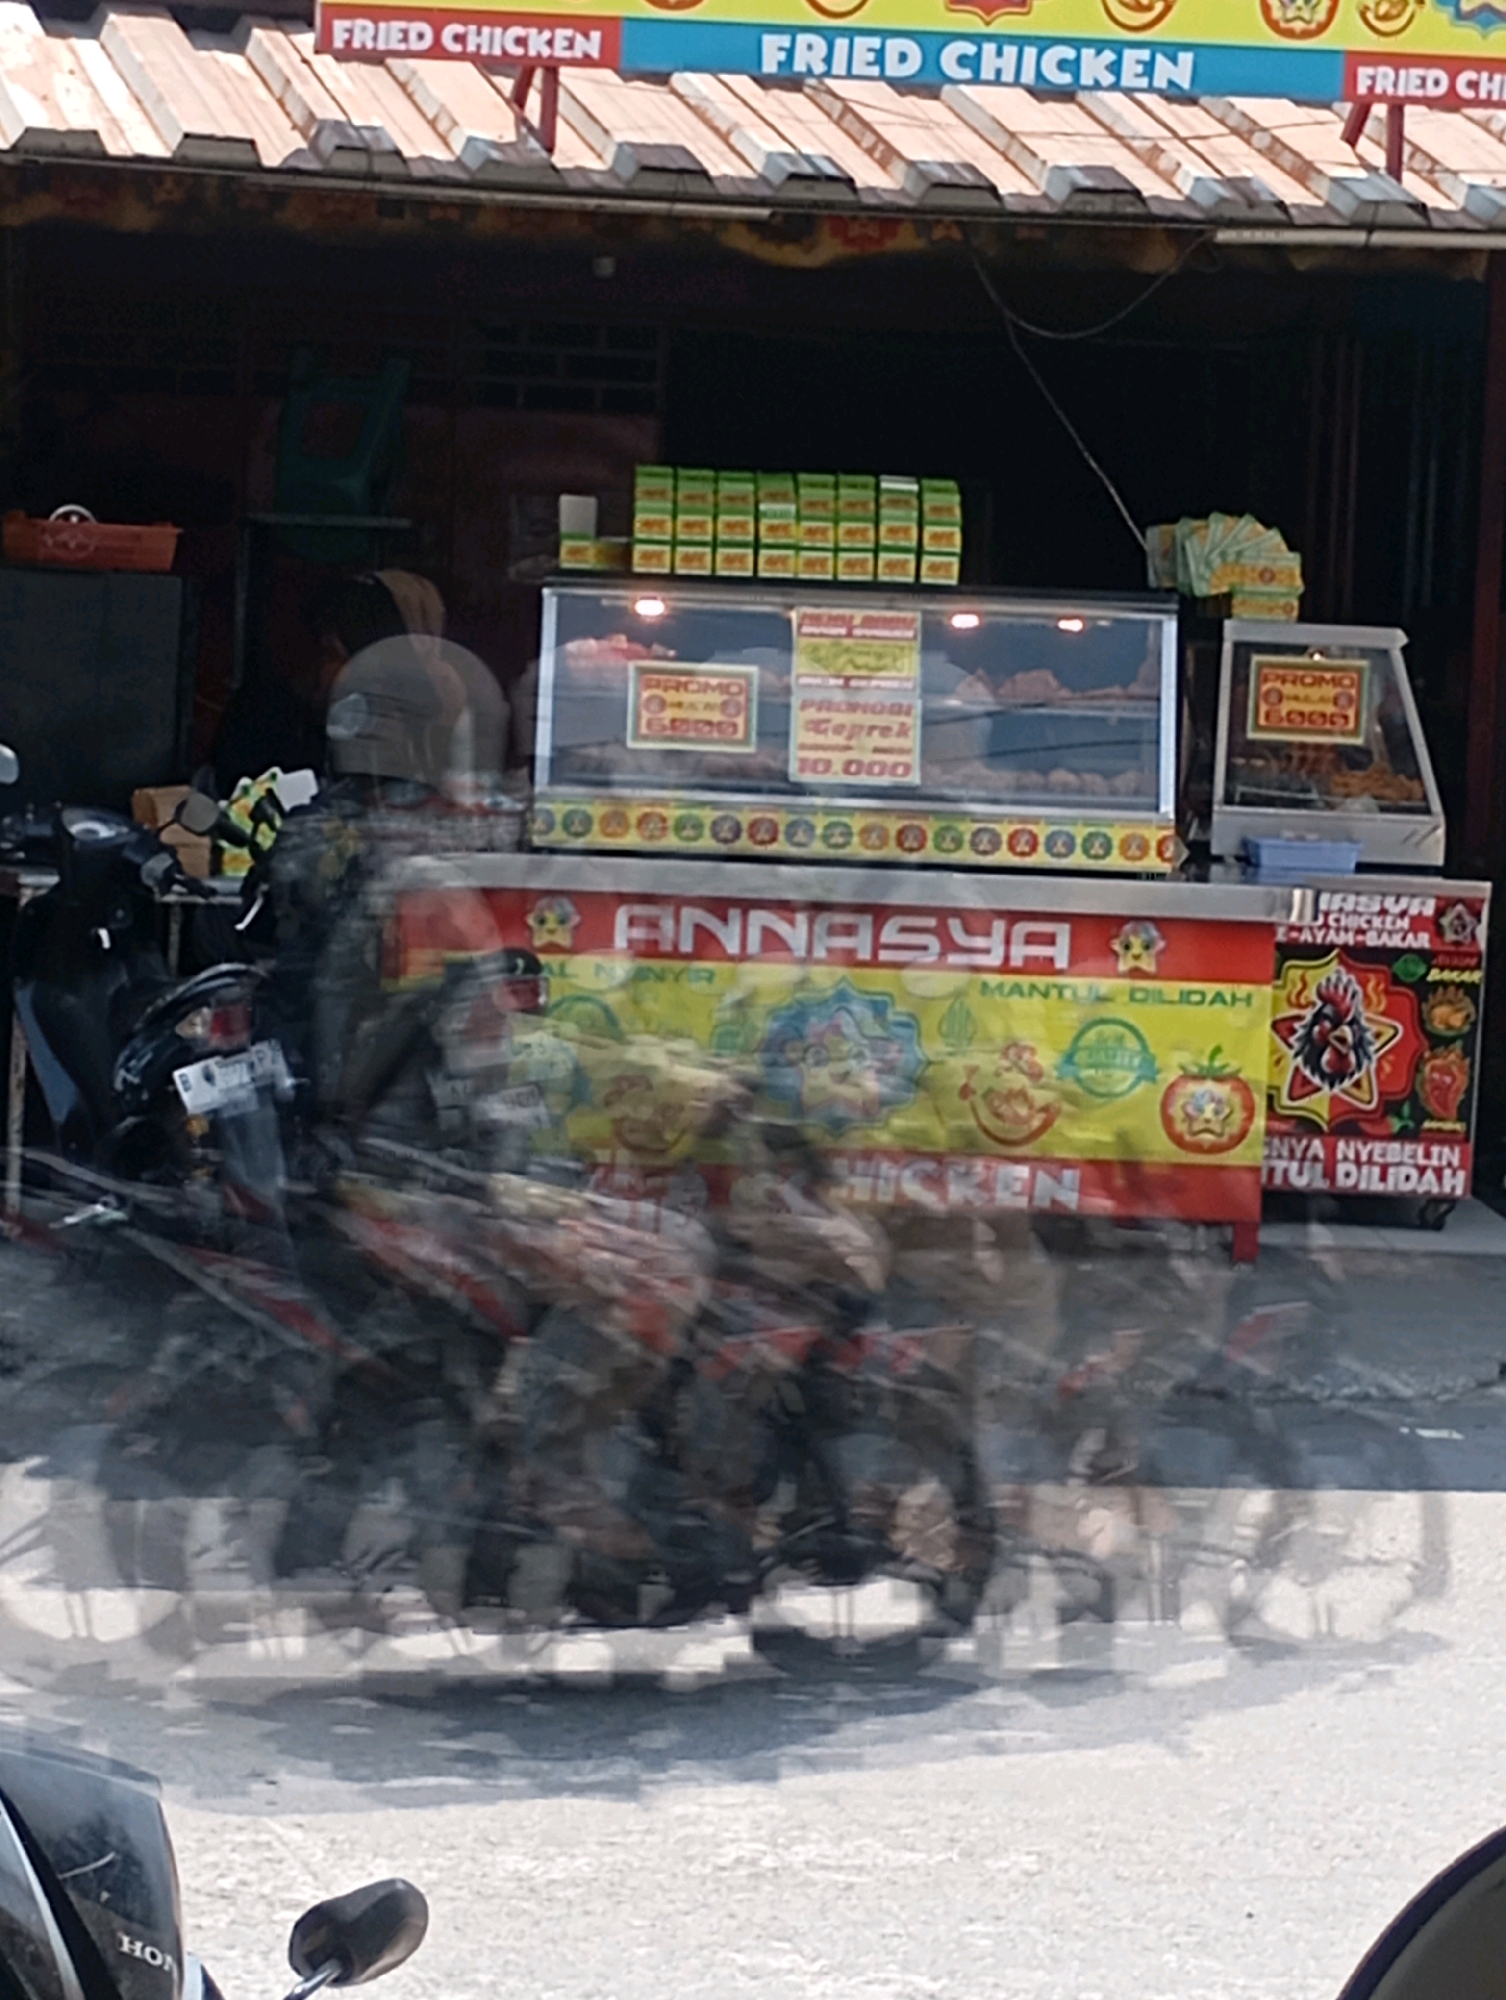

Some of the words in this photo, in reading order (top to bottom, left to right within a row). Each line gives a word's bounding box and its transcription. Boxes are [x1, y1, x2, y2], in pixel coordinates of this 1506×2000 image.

[331, 18, 434, 52] FRIED
[441, 22, 601, 60] CHICKEN
[761, 33, 923, 79] FRIED
[939, 40, 1195, 91] CHICKEN
[1356, 65, 1450, 98] FRIED
[643, 677, 743, 697] PROMO
[1263, 671, 1356, 689] PROMO
[797, 756, 913, 779] 10.000
[1328, 913, 1411, 931] CHICKEN
[612, 903, 1071, 971] ANNASYA
[979, 980, 1115, 1005] MANTUL
[1128, 988, 1254, 1009] DILIDAH
[1336, 1140, 1461, 1169] NYEBELIN
